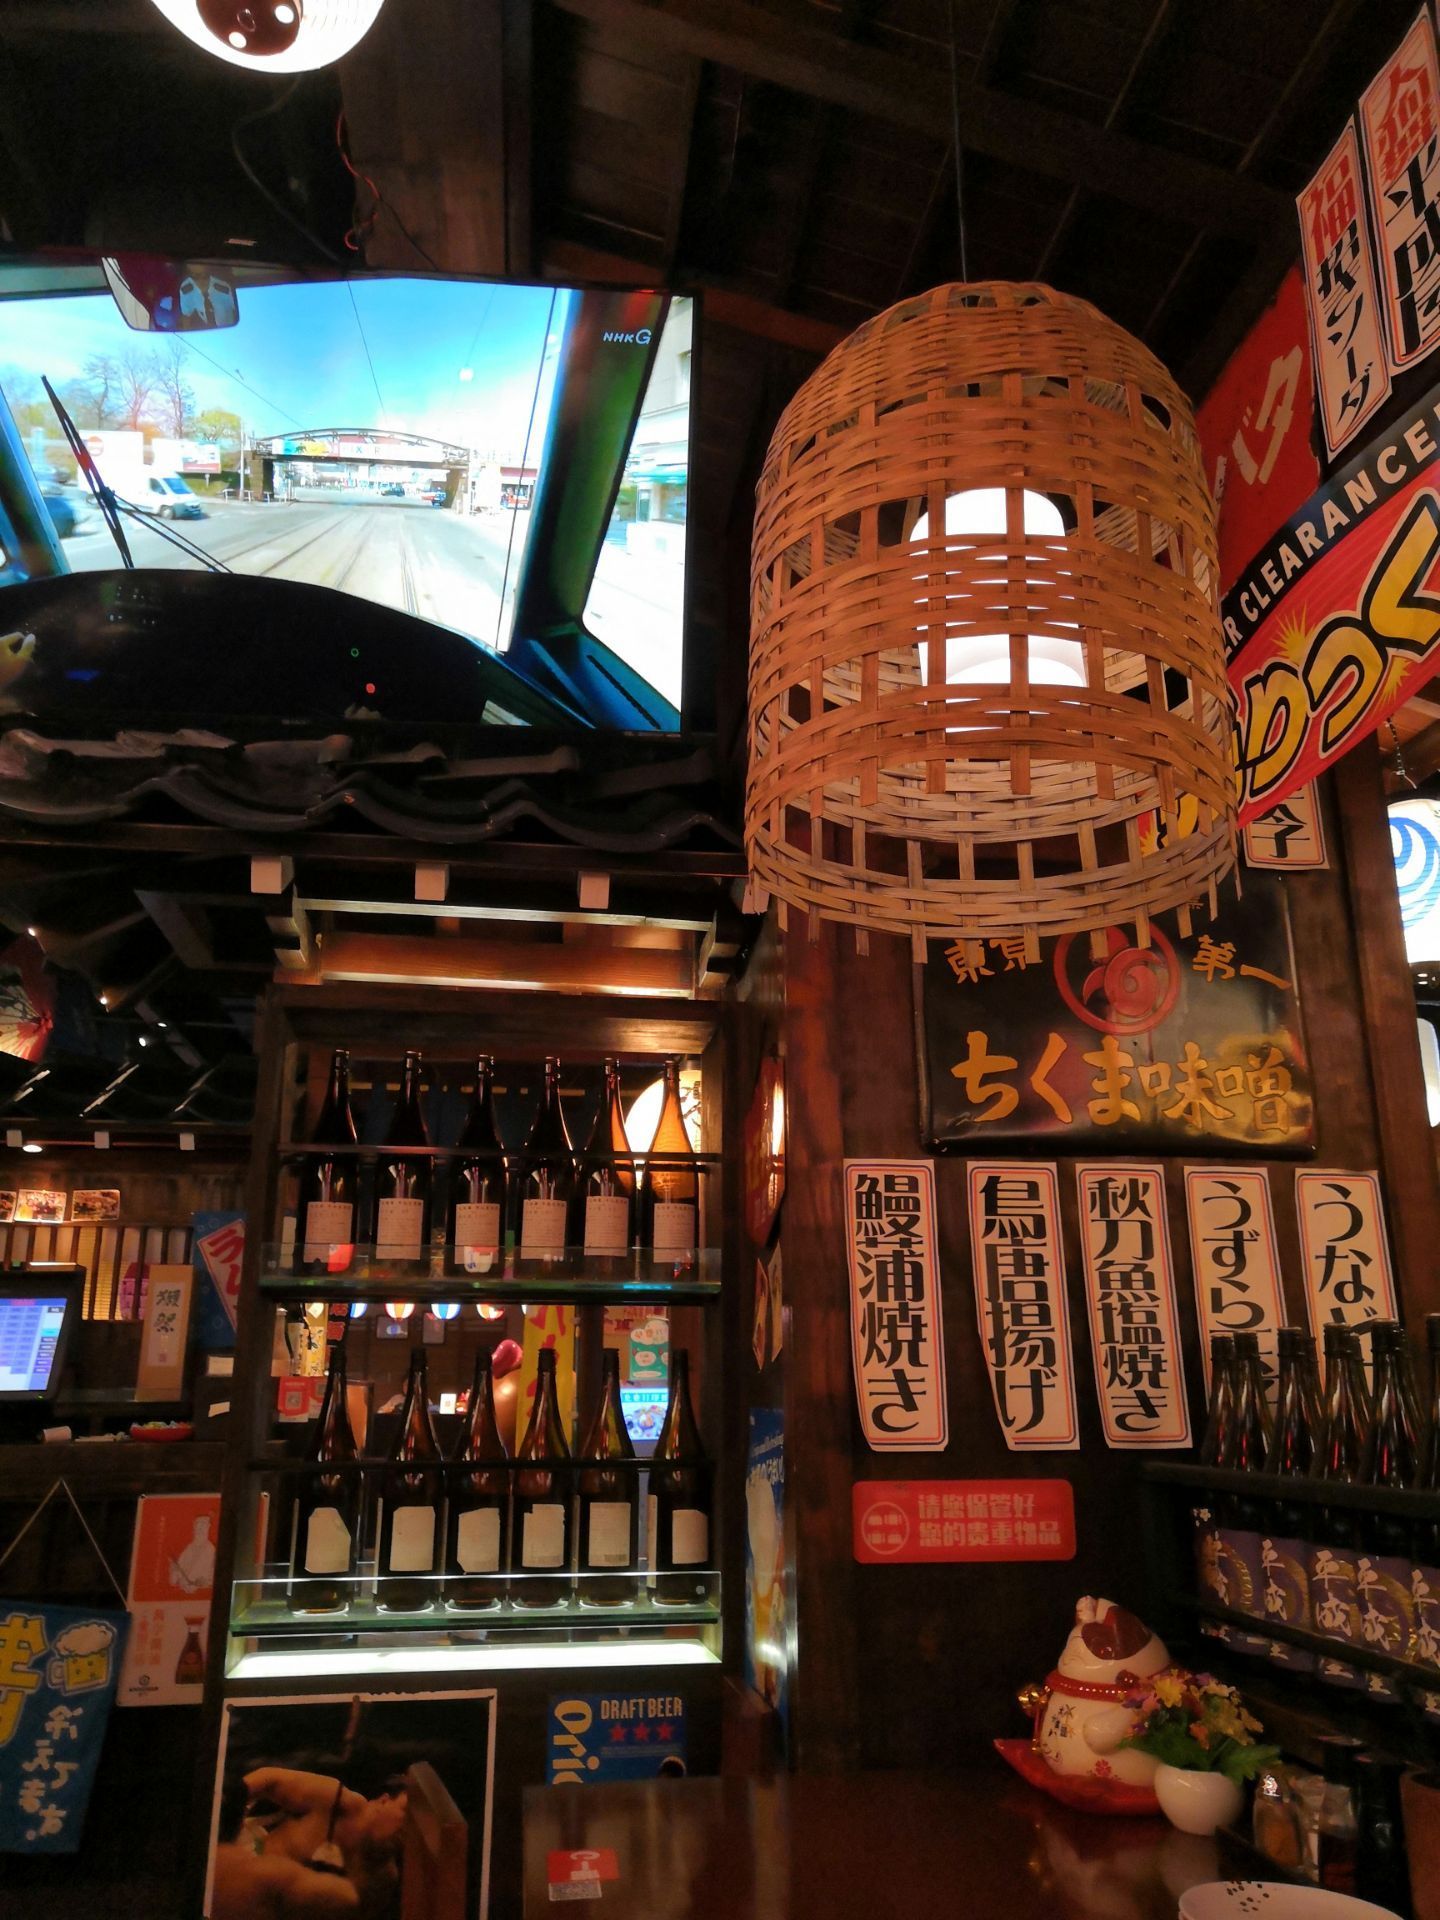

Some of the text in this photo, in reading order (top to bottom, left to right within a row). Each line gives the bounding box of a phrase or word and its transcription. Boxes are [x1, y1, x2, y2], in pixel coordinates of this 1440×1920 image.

[1240, 418, 1439, 622] CLEARANCE
[1192, 934, 1293, 990] 第一
[951, 1030, 1293, 1135] ちくま味噌
[854, 1173, 929, 1433] 鰻蒲焼き
[979, 1175, 1058, 1434] 鳥唐揚げ
[1087, 1176, 1170, 1433] 秋刀魚塩焼き
[917, 1493, 1036, 1519] 请您保管好
[919, 1520, 1062, 1548] 您的贵重物品
[600, 1696, 683, 1720] DRAFT BEER
